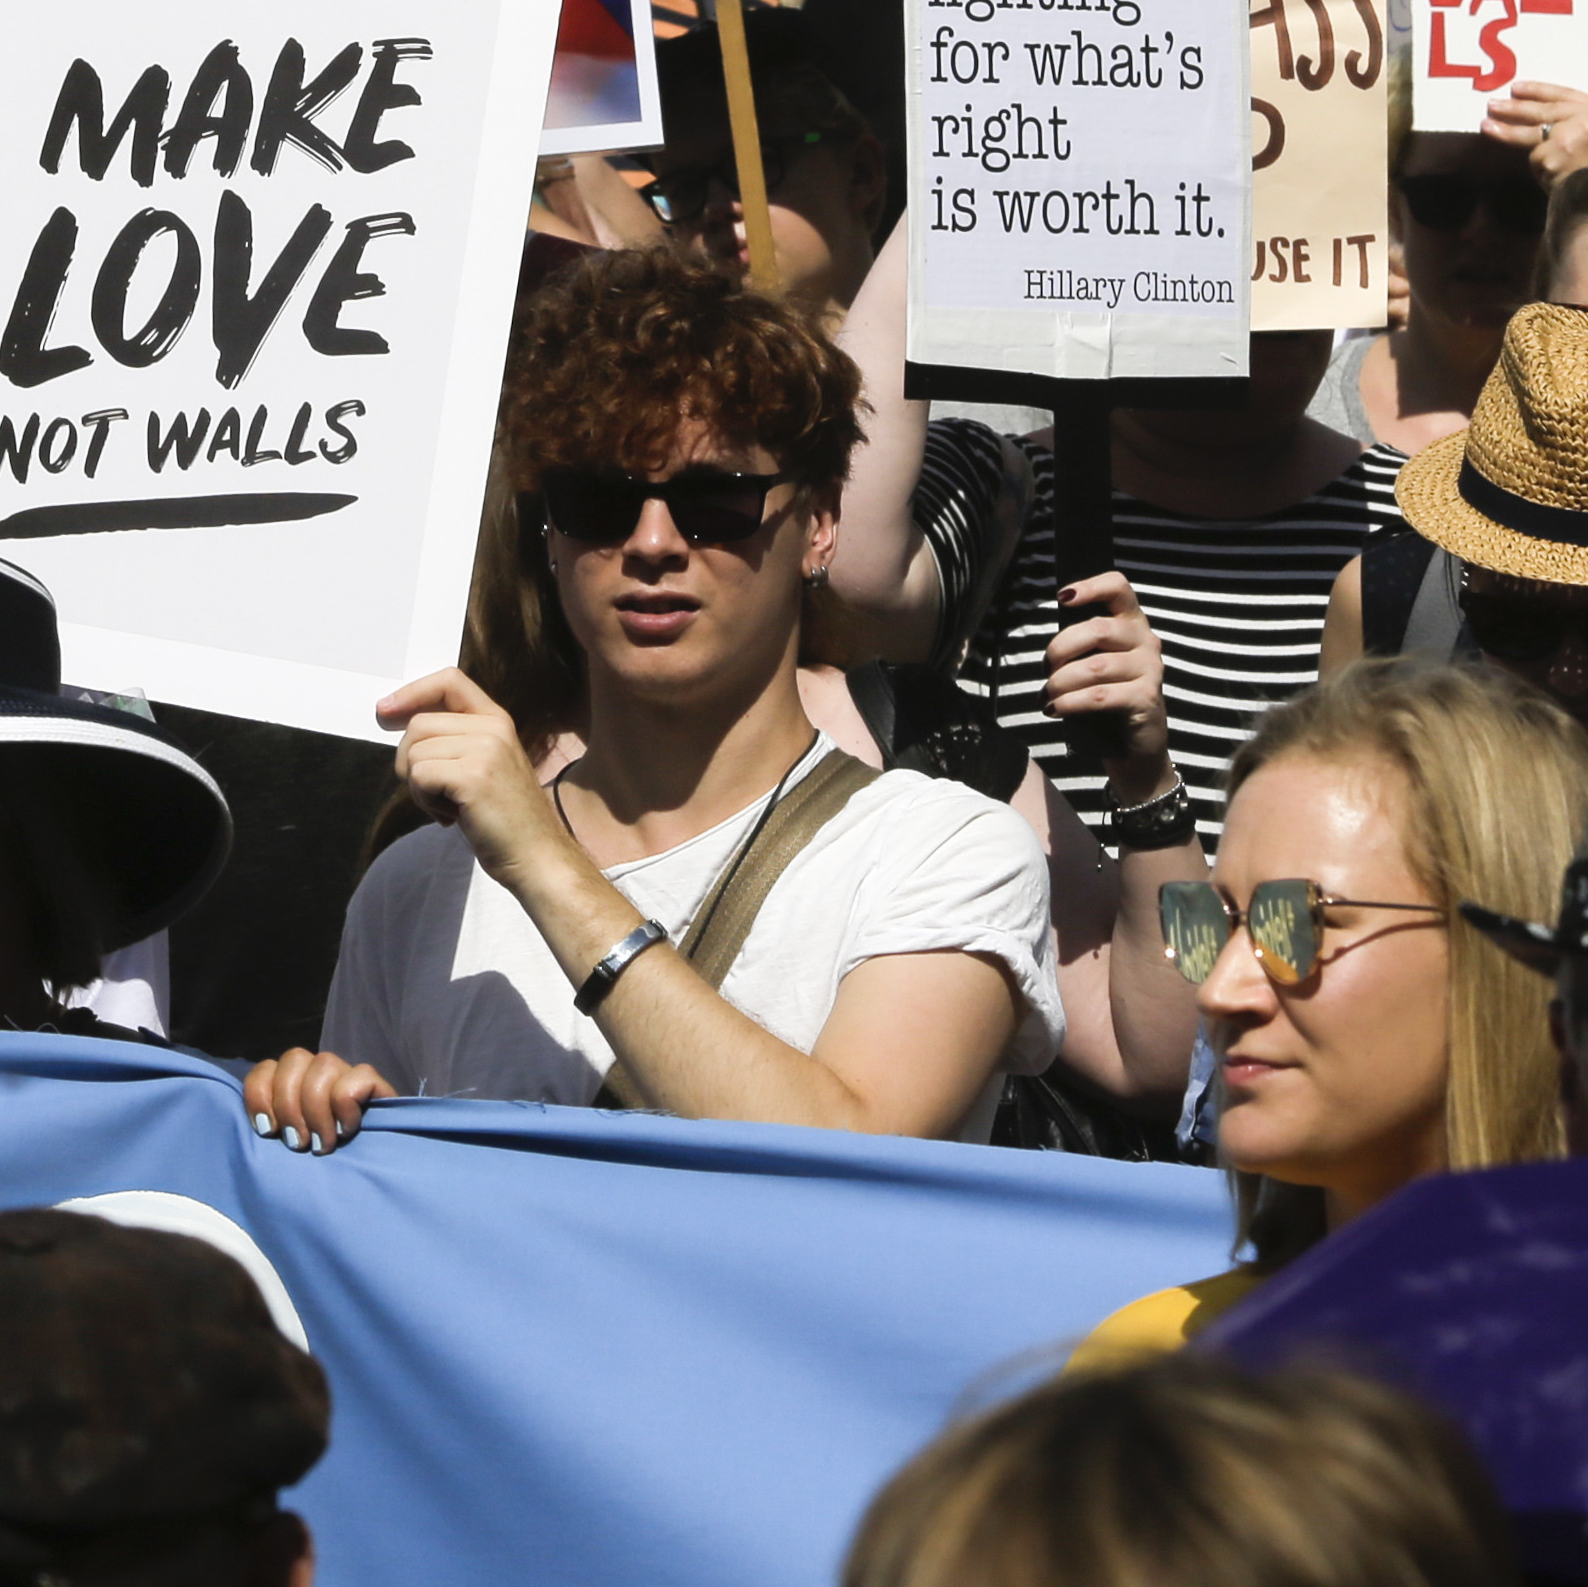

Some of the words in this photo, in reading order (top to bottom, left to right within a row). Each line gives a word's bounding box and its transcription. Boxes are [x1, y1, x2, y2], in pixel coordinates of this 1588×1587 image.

[930, 26, 1010, 84] for
[1024, 30, 1204, 90] what's
[1428, 11, 1517, 92] LS
[40, 37, 433, 188] MAKE
[931, 103, 1071, 173] right
[931, 176, 977, 232] is
[993, 179, 1160, 235] worth
[1175, 182, 1225, 238] it.
[1024, 269, 1125, 308] Hillary
[1133, 271, 1235, 303] Clinton
[1332, 234, 1376, 289] IT
[147, 399, 366, 474] WALLS
